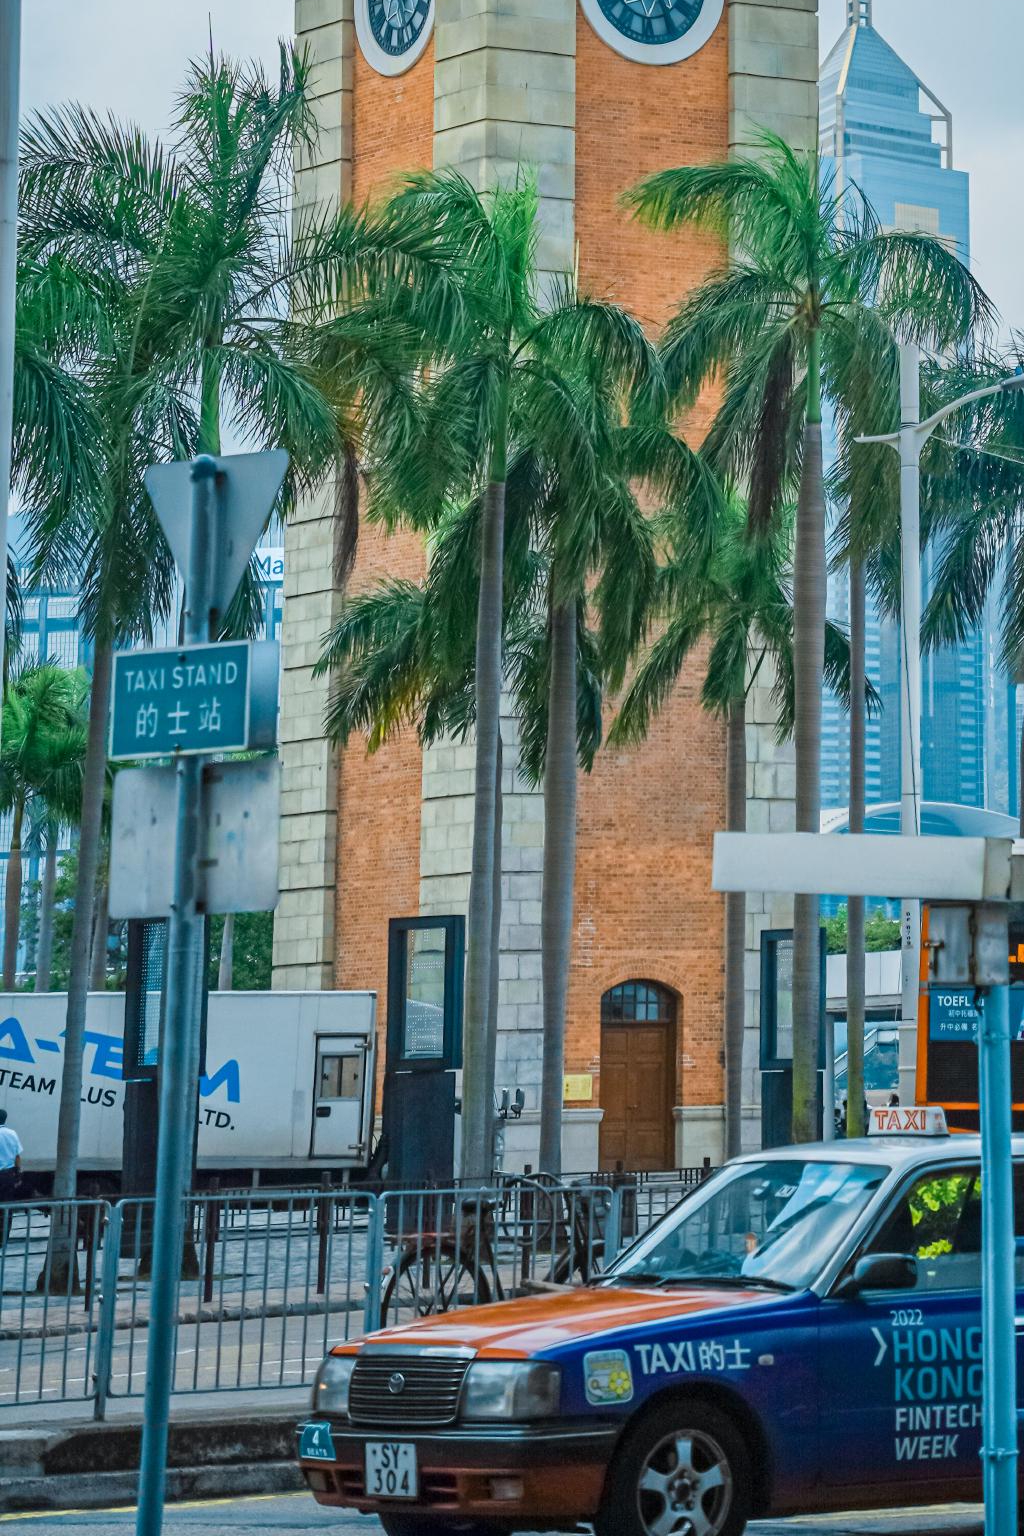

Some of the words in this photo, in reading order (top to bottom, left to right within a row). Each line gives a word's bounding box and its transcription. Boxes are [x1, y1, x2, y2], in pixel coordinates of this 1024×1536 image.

[125, 667, 165, 693] TAXI
[171, 661, 238, 689] STAND
[135, 695, 222, 739] 的士站
[937, 995, 971, 1007] TOEFL
[81, 1086, 117, 1108] US
[199, 1108, 235, 1131] TD.
[874, 1109, 927, 1130] TAXI
[890, 1308, 924, 1326] 2022
[633, 1341, 697, 1375] TAXI
[698, 1339, 752, 1372] 的士
[893, 1326, 983, 1363] HONG
[895, 1403, 983, 1432] FINTECH
[312, 1430, 320, 1446] 4
[895, 1434, 960, 1461] WEEK
[381, 1444, 401, 1469] SY
[374, 1468, 410, 1494] 304
